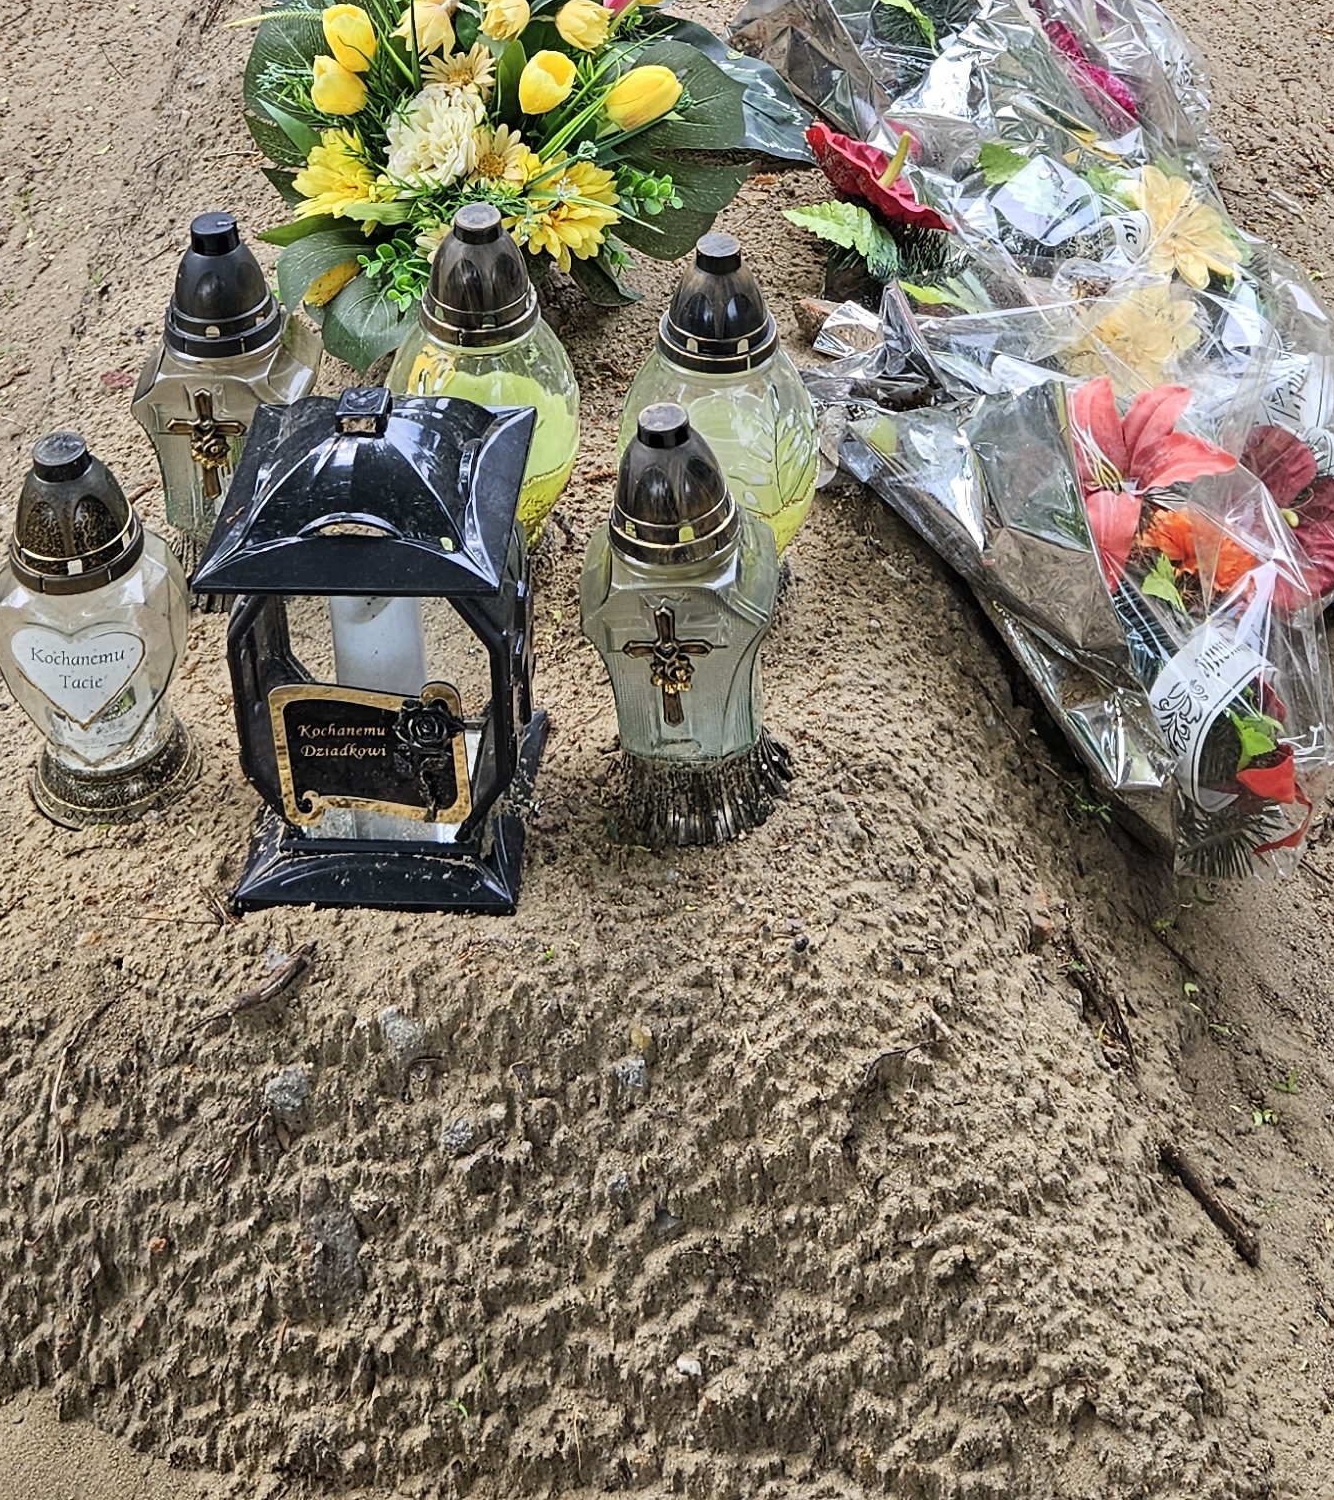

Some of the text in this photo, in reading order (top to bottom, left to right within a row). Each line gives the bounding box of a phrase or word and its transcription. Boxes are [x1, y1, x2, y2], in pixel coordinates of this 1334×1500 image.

[31, 647, 125, 666] Kochanemu
[59, 674, 104, 690] Tacie
[297, 723, 386, 739] Kochanemu
[300, 743, 387, 759] Dziadkowi
